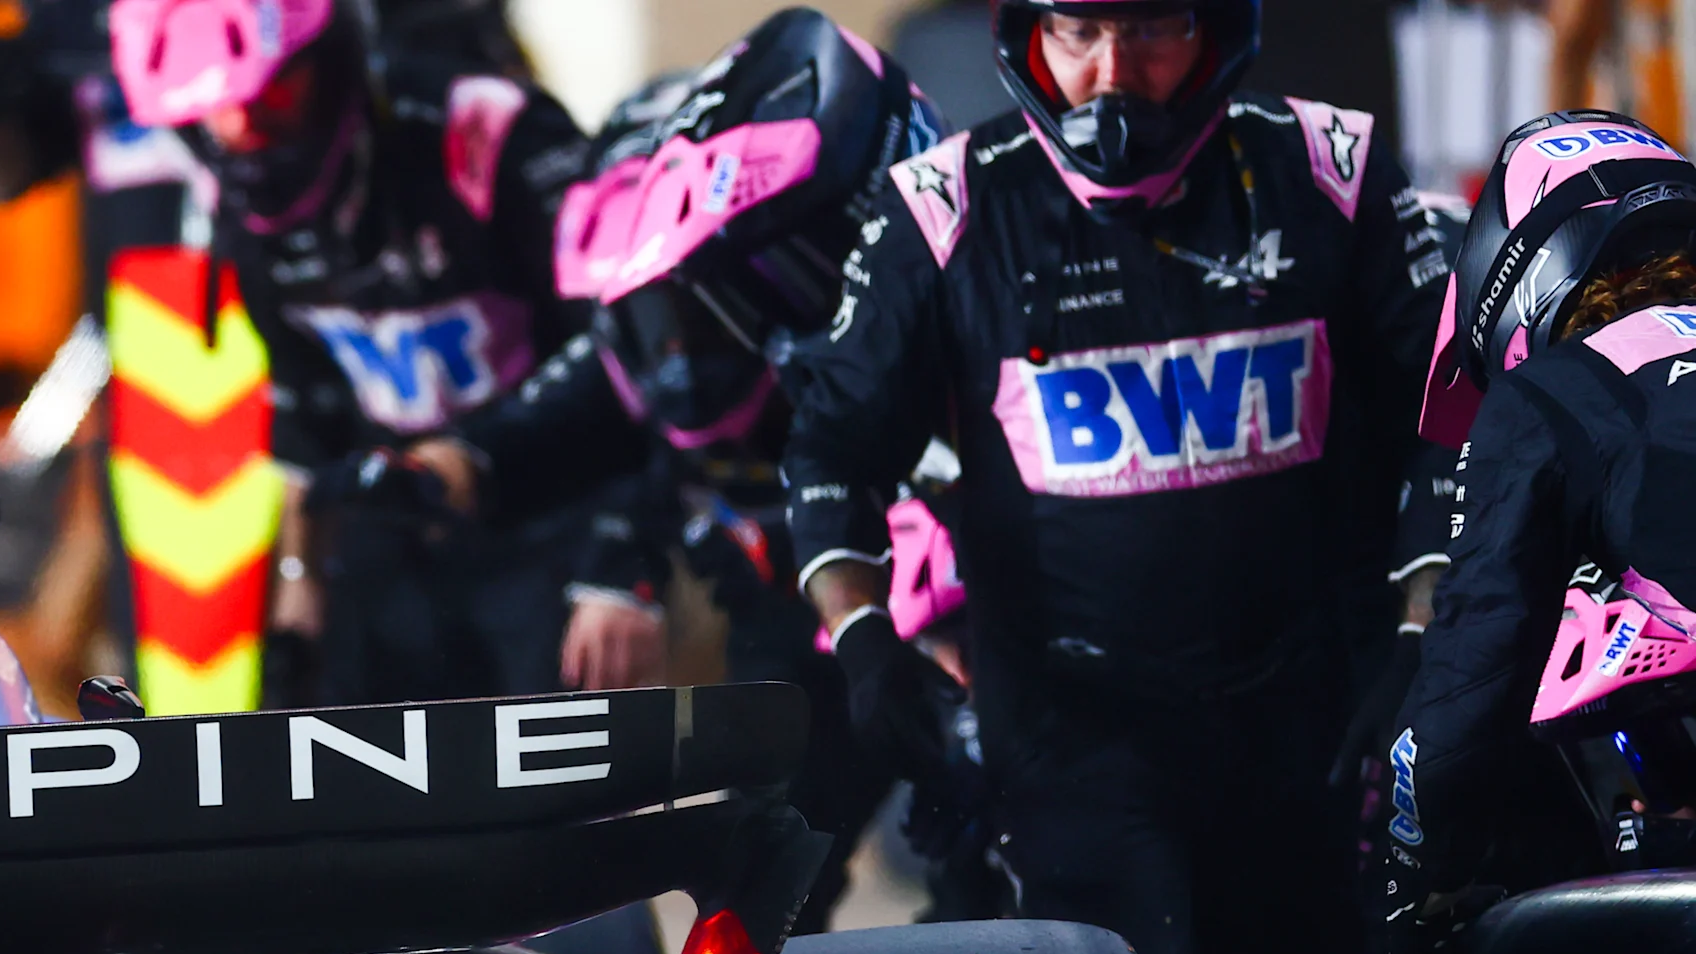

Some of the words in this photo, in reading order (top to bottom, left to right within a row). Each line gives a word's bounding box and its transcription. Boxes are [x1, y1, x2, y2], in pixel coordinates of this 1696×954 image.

[1590, 127, 1687, 162] BW
[1477, 237, 1526, 326] shamir
[1034, 336, 1307, 467] BWT
